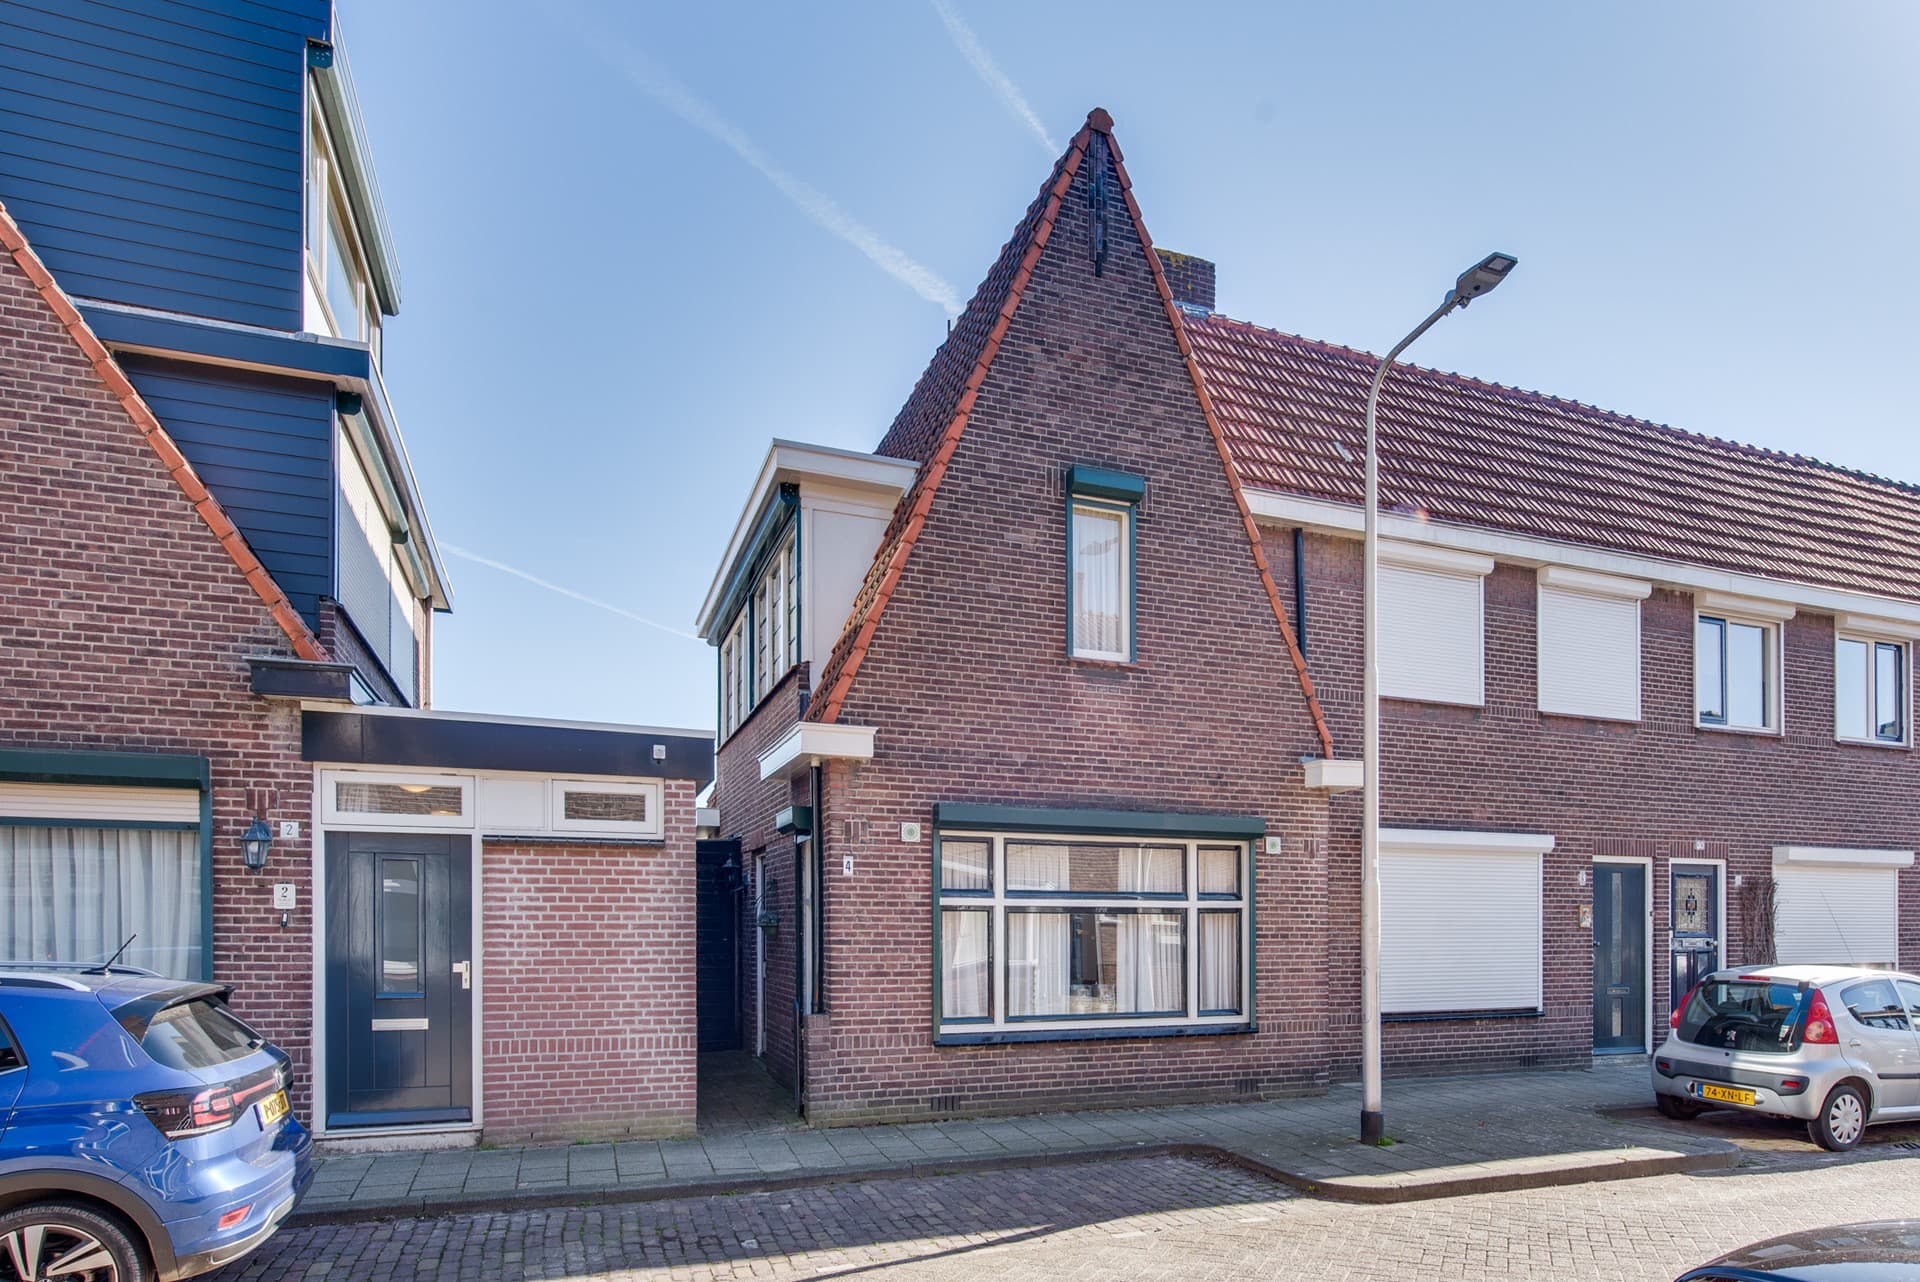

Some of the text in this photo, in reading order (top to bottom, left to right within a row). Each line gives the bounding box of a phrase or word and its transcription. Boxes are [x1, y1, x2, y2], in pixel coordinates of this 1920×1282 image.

[286, 823, 293, 836] 2
[845, 860, 851, 873] 4
[281, 886, 288, 898] 2
[1704, 1086, 1751, 1103] 74-XN-LF
